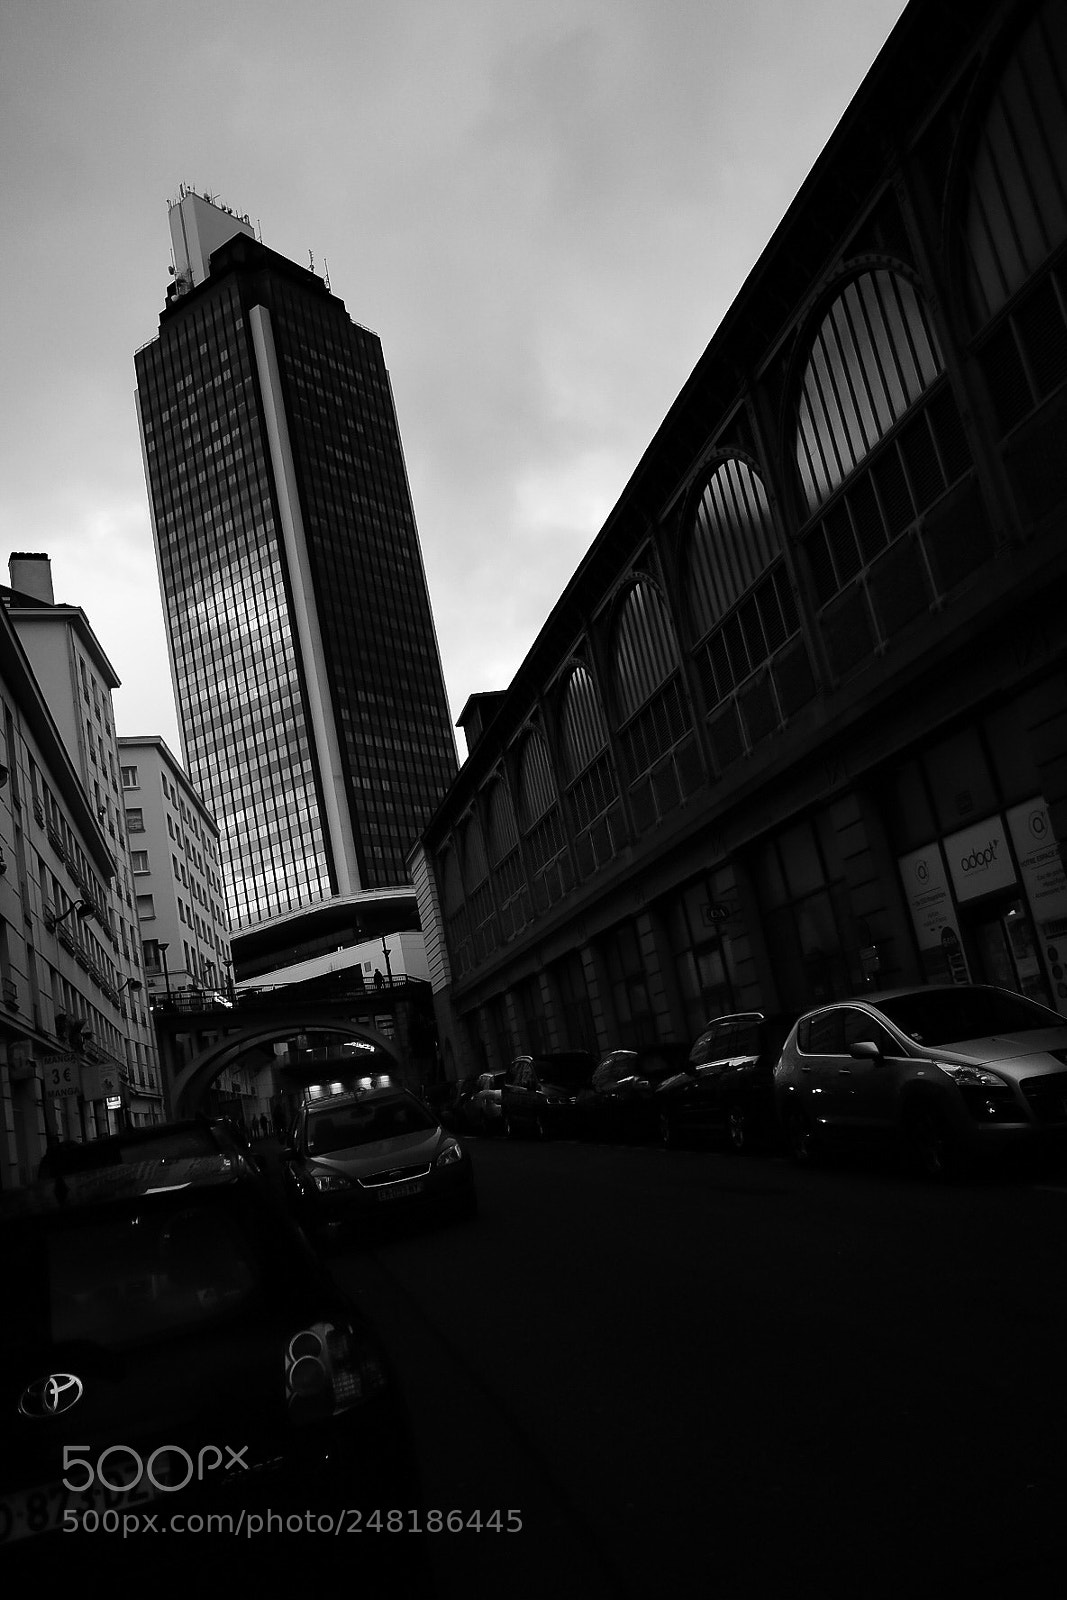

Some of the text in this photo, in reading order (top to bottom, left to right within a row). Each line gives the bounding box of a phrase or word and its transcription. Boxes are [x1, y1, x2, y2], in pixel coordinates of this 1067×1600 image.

[44, 1054, 76, 1064] MANGA
[52, 1069, 60, 1084] 3
[47, 1087, 80, 1097] MANGA
